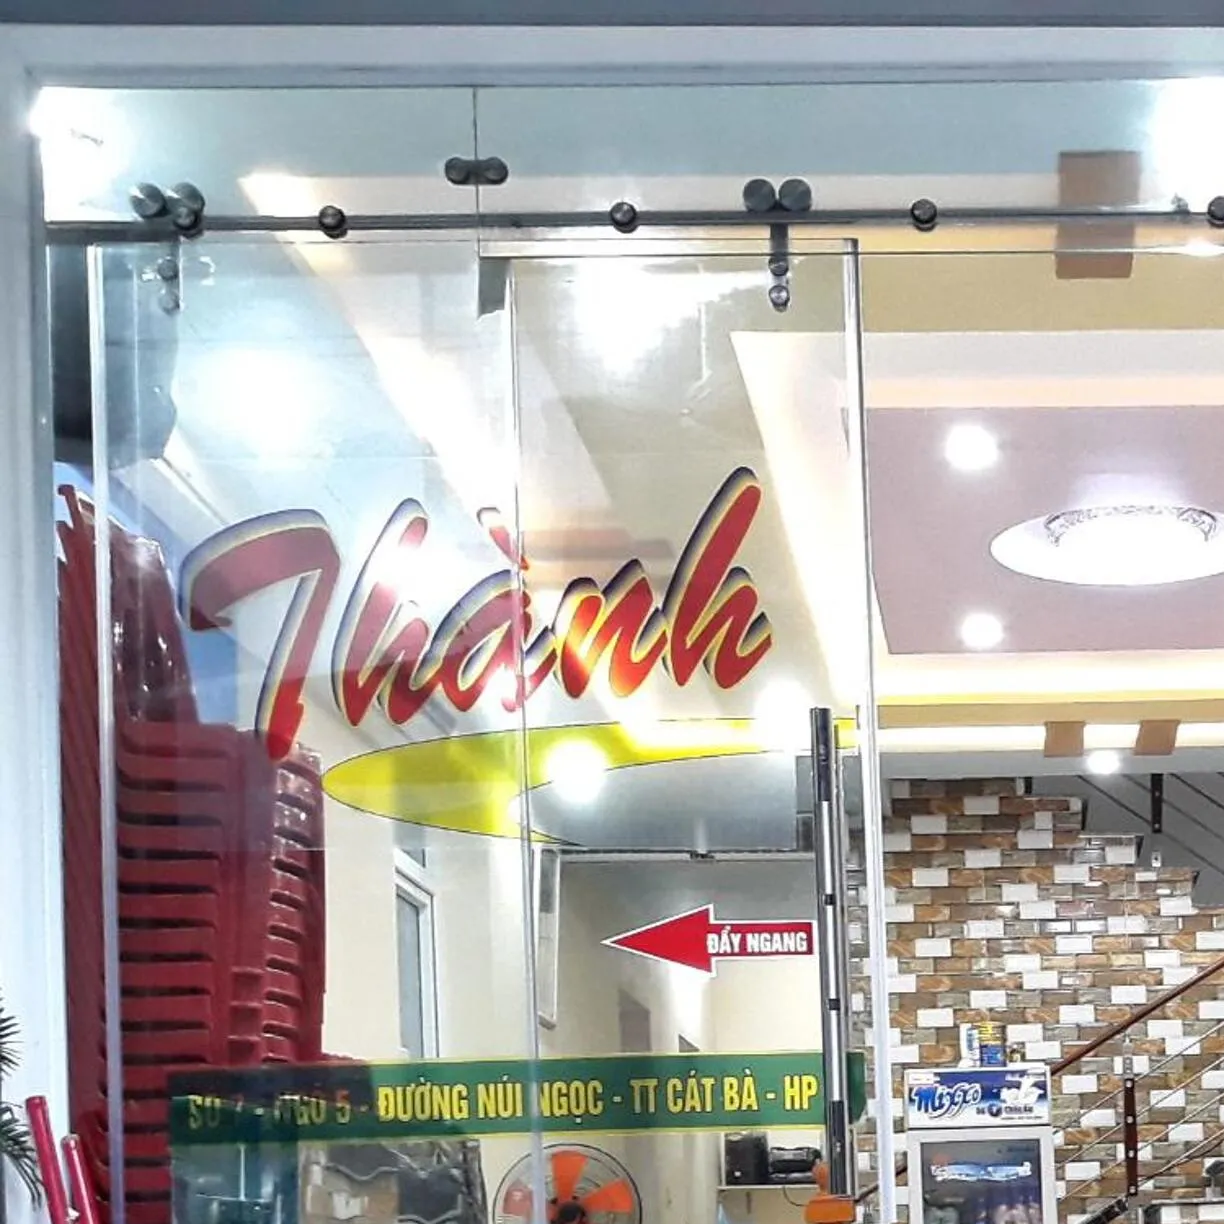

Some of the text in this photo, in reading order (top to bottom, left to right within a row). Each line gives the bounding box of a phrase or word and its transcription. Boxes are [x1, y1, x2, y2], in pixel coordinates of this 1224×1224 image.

[179, 466, 772, 762] Thành
[746, 932, 808, 953] NGANG
[378, 1076, 471, 1122] ĐƯỜNG
[477, 1075, 523, 1118] NÚI
[538, 1079, 603, 1124] NGỌC
[630, 1077, 660, 1113] TT
[666, 1069, 716, 1113] CÁT
[723, 1067, 759, 1111] BÀ
[784, 1074, 819, 1111] HP
